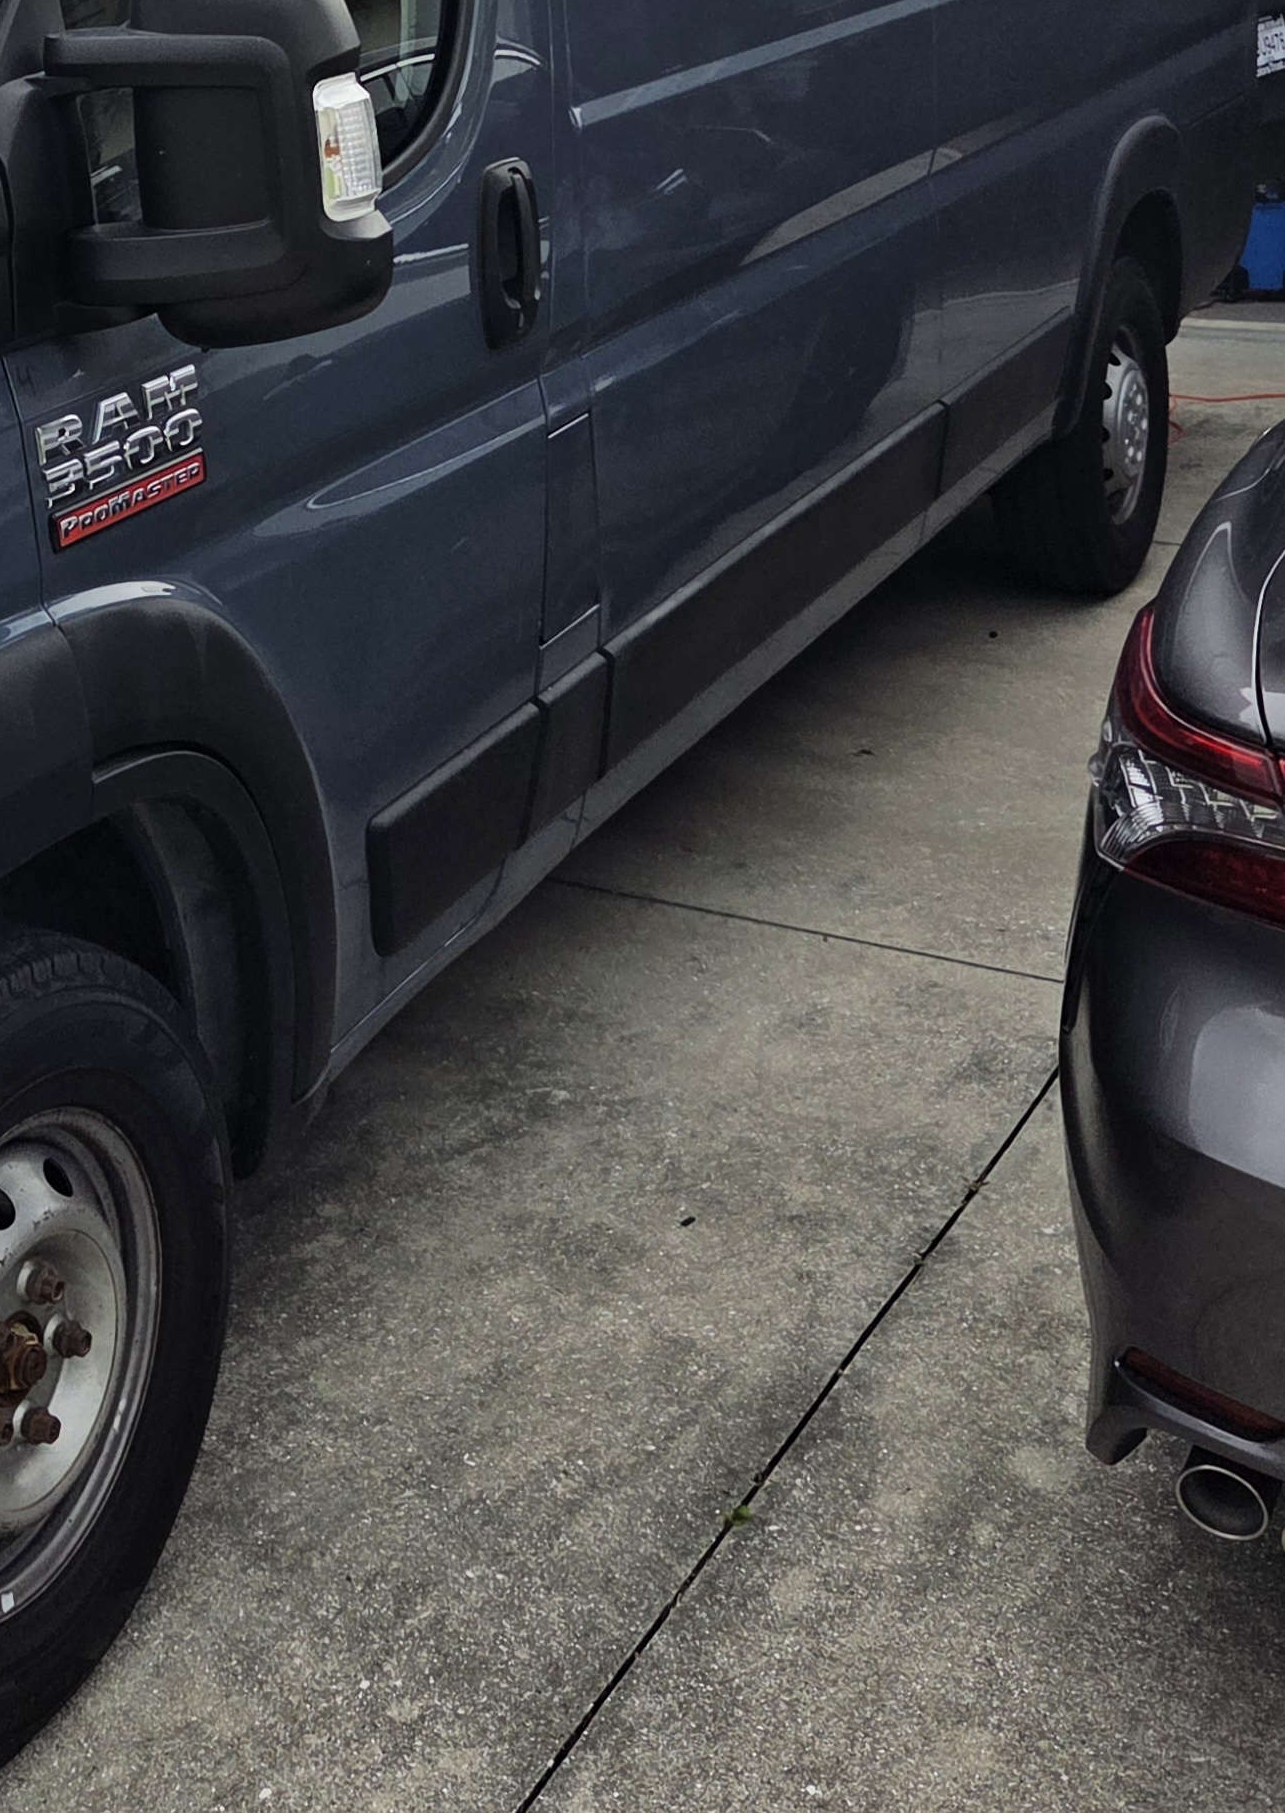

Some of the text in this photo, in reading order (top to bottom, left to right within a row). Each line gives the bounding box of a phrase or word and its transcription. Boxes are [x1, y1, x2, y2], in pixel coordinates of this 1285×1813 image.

[34, 364, 198, 465] RAM
[42, 408, 202, 509] 3500
[60, 462, 200, 538] PROMASTER
